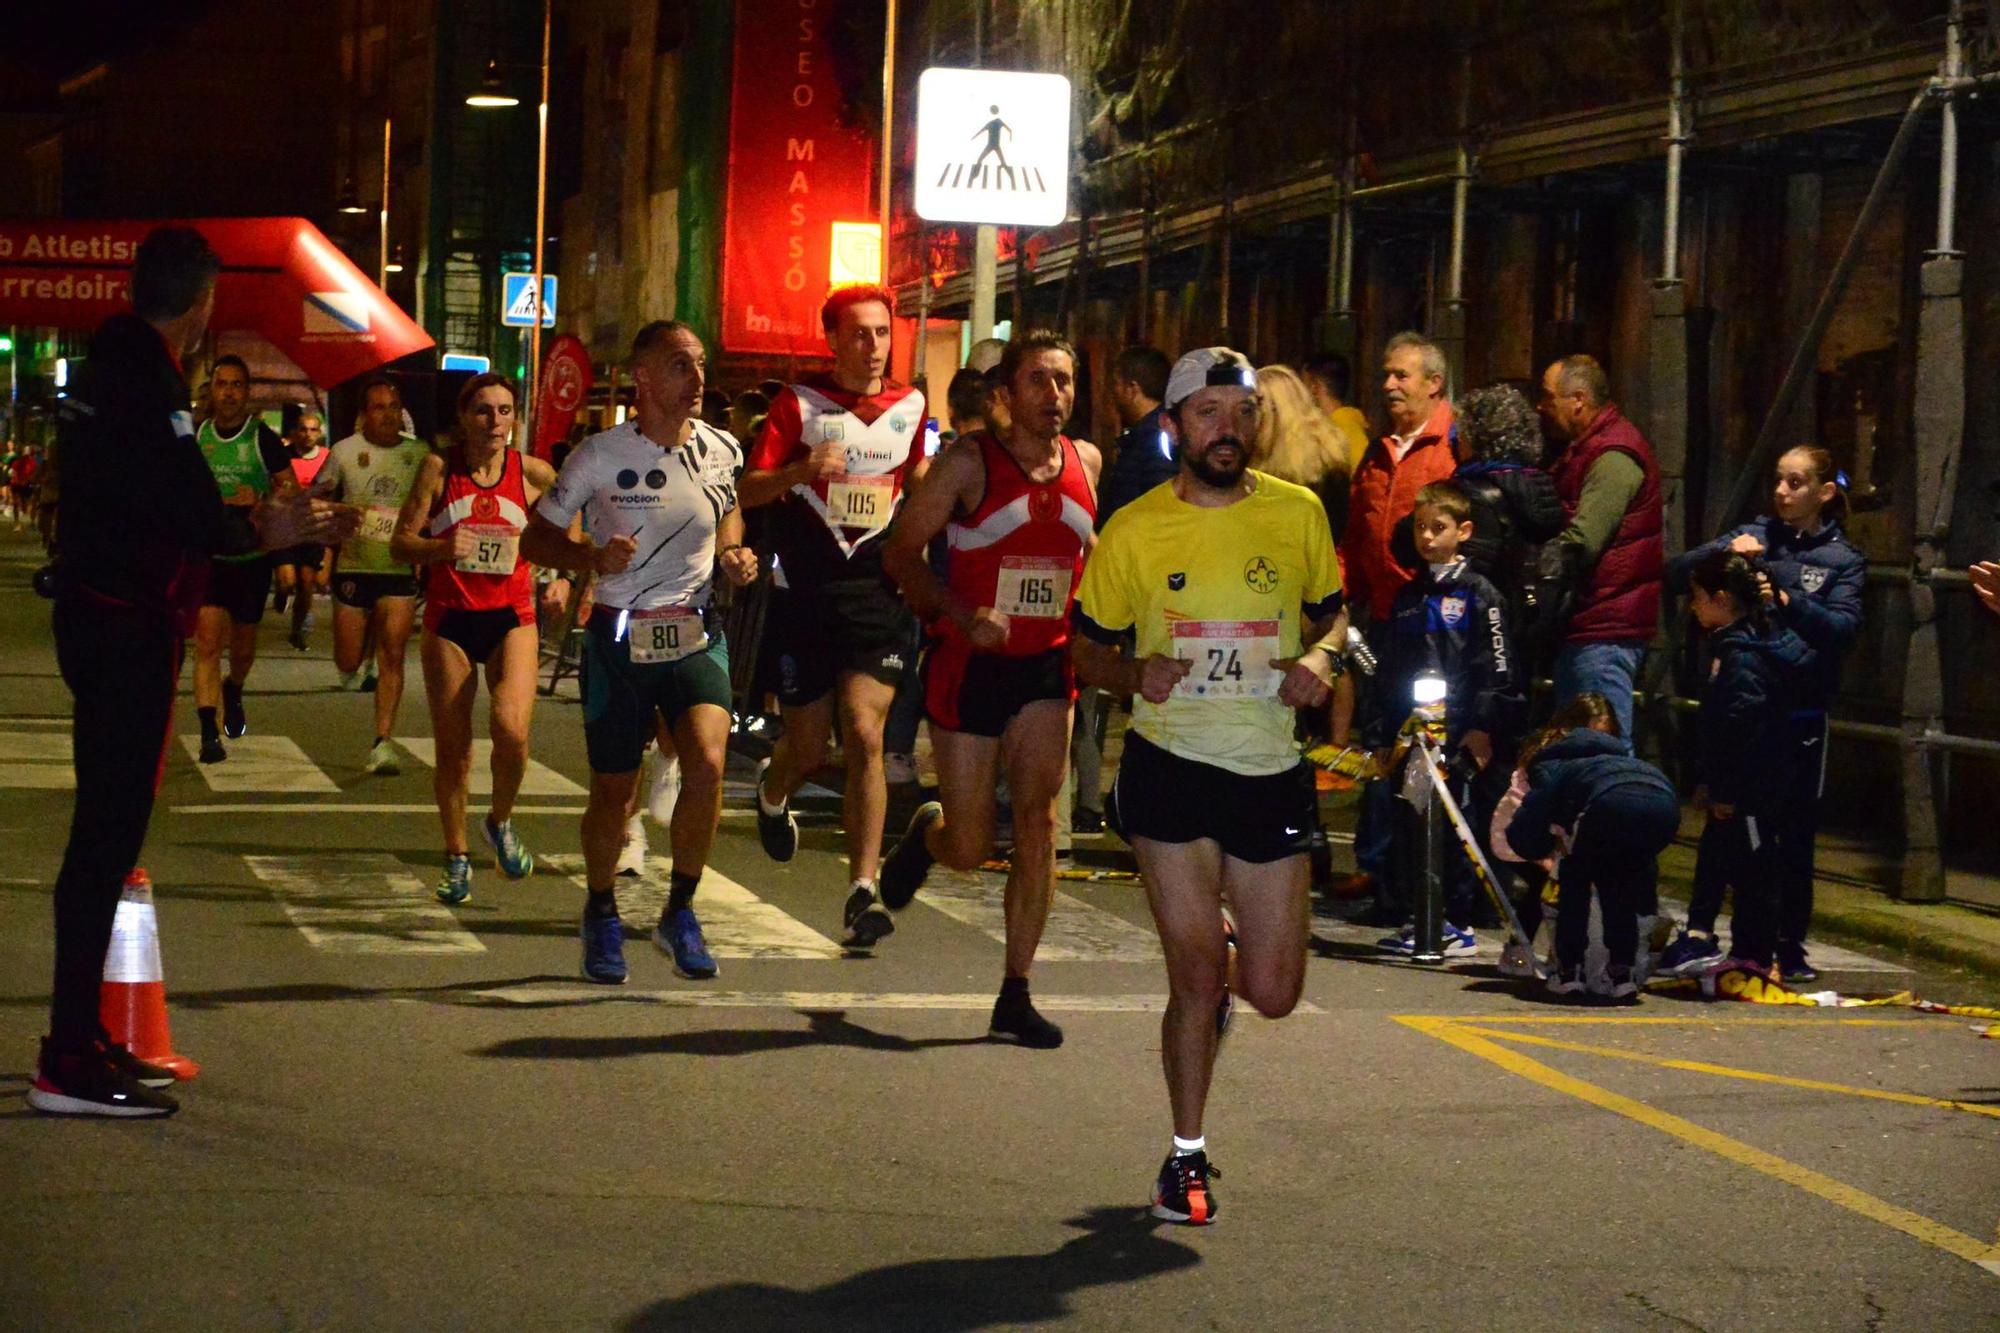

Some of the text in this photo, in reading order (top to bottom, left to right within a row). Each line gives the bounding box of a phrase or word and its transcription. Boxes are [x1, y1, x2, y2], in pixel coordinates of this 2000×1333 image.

[847, 491, 876, 515] 105
[478, 542, 502, 563] 57
[1019, 578, 1053, 604] 165
[653, 624, 679, 649] 80
[1207, 649, 1243, 681] 24
